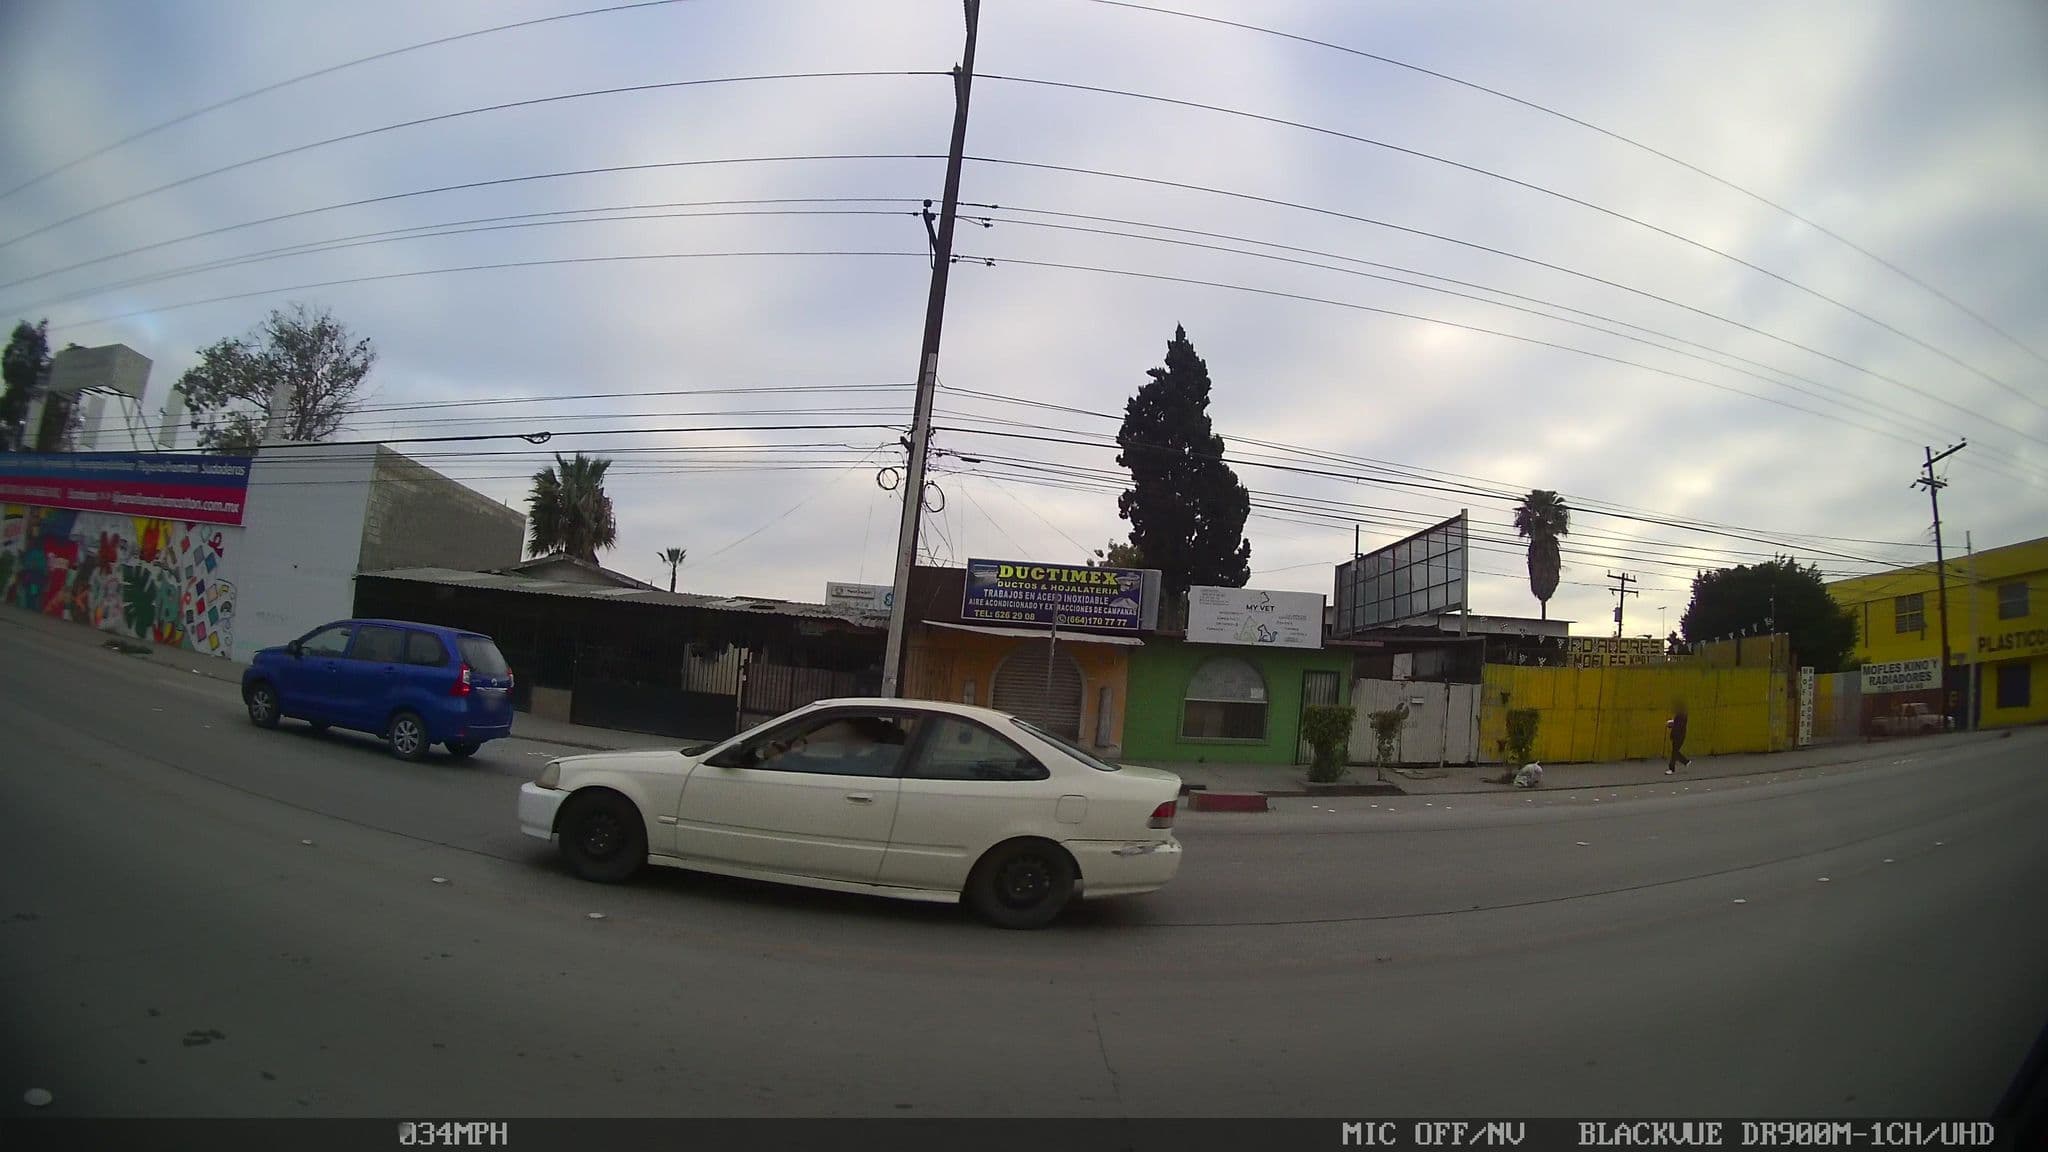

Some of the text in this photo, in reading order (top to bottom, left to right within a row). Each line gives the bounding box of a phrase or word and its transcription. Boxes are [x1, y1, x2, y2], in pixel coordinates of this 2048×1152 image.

[998, 564, 1118, 586] DUCTIMEX
[997, 580, 1037, 590] DUCTOS
[1050, 584, 1119, 596] HOJALATERIA
[983, 588, 1023, 600] TRABAJOS
[1025, 591, 1036, 601] EN
[1063, 593, 1110, 606] INOXIDABLE
[968, 598, 984, 607] AIRE
[985, 599, 1038, 610] ACONDICIONADO
[1044, 602, 1093, 614] EXRACCIONES
[1094, 606, 1102, 614] DE
[974, 609, 993, 618] TEL:
[994, 611, 1010, 619] 626
[1012, 612, 1023, 620] 29
[1024, 613, 1036, 621] 08
[1104, 618, 1116, 626] 77
[1117, 619, 1128, 627] 77
[1863, 663, 1902, 675] MOFLES
[1869, 671, 1932, 686] RADIADORES
